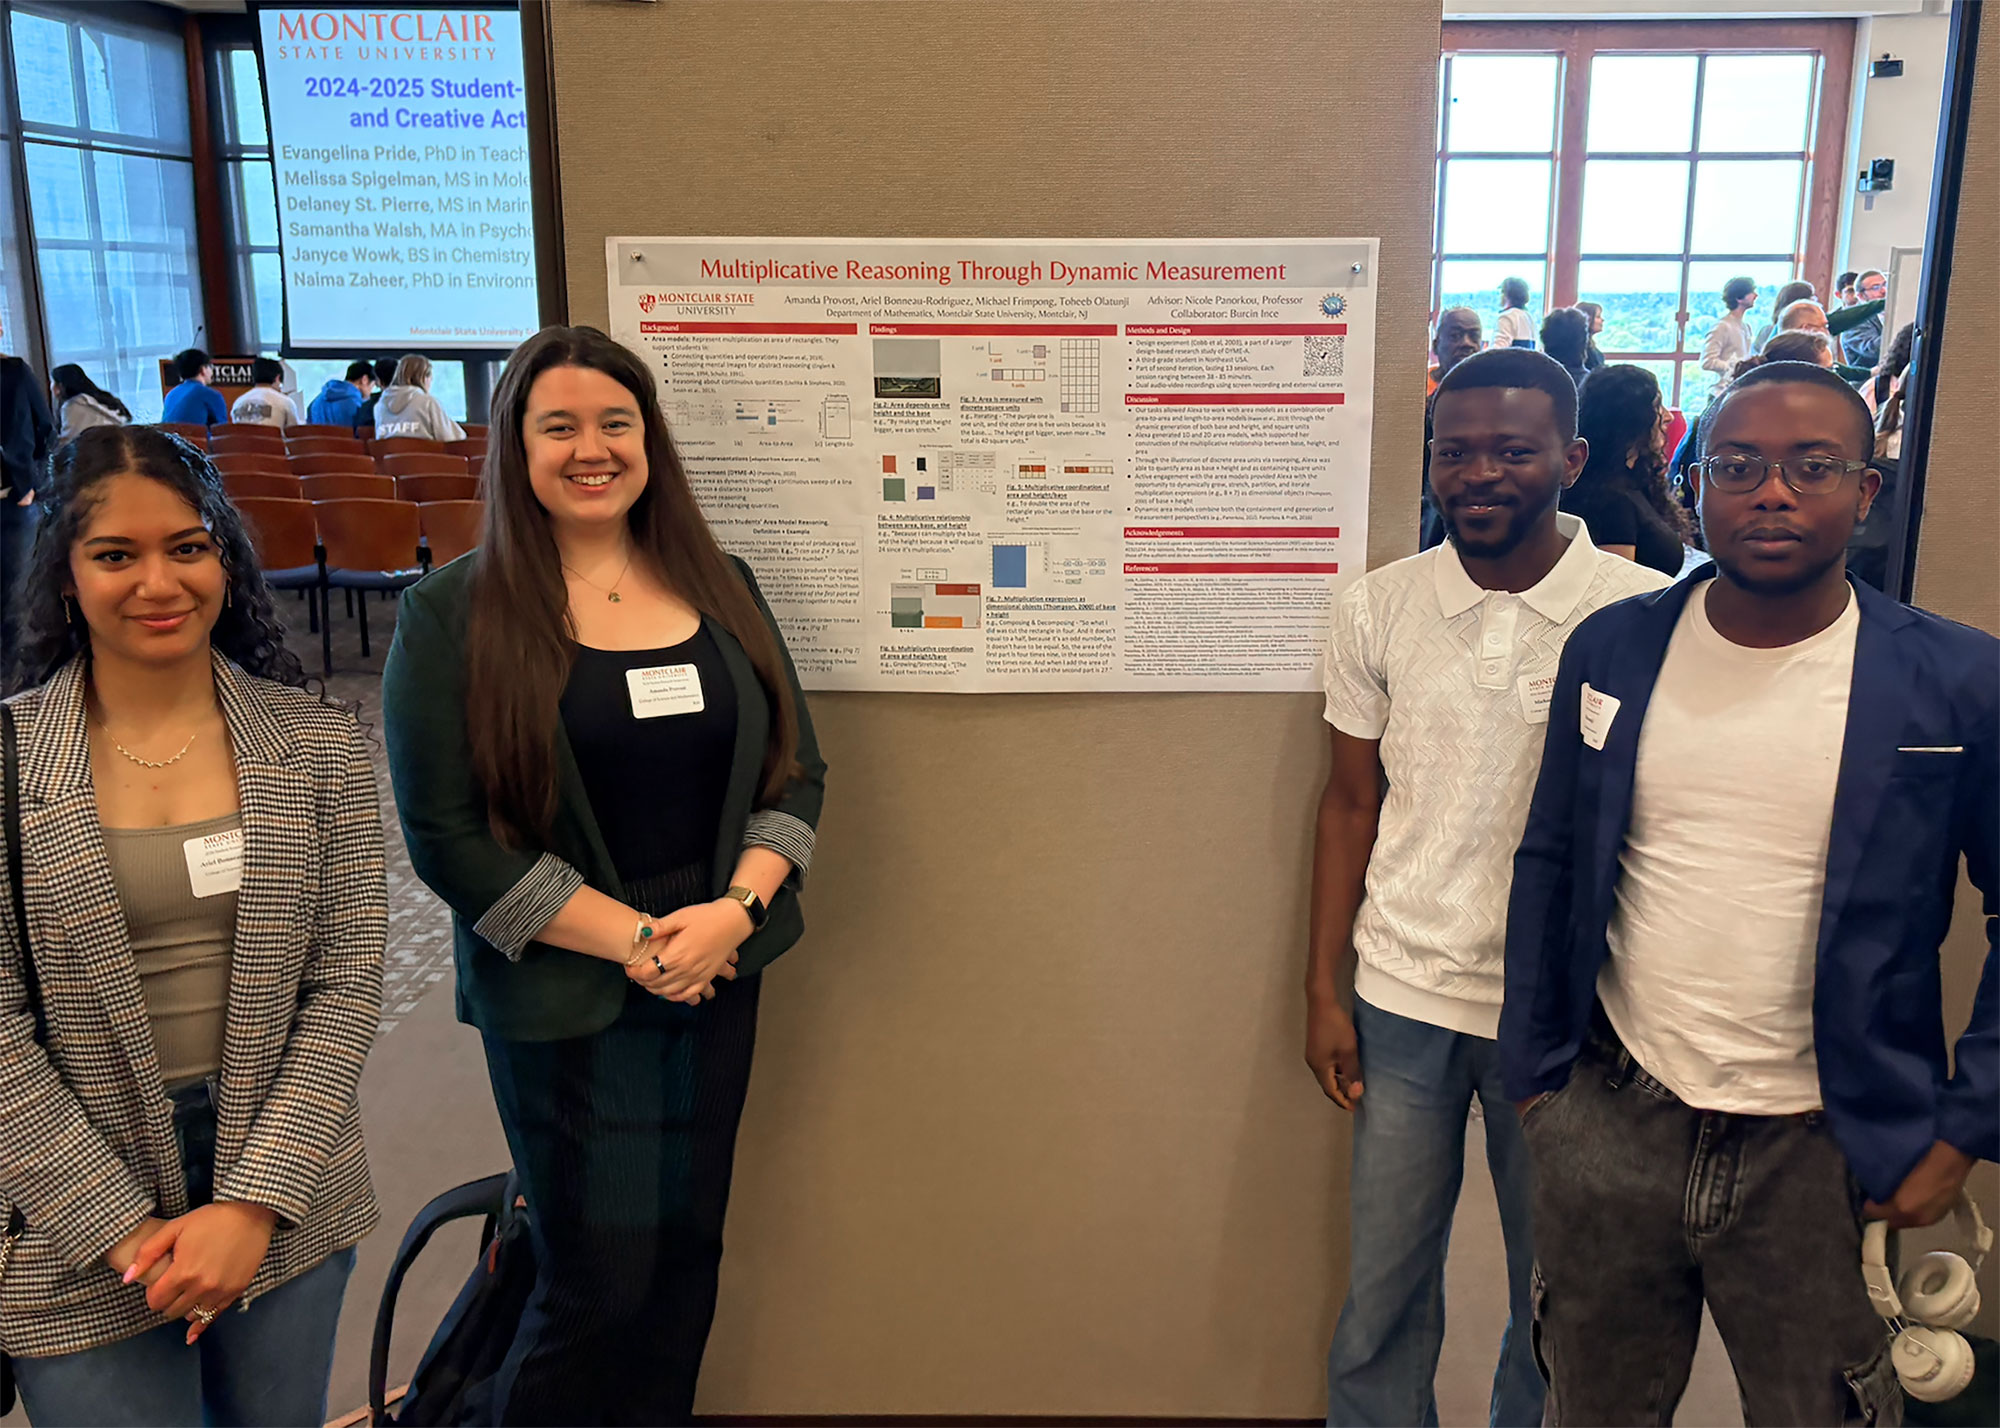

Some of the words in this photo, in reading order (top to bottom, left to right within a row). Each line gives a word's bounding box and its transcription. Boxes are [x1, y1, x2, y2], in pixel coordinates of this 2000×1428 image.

[278, 13, 495, 42] MONTCLAIR
[279, 46, 344, 60] STATE
[358, 46, 496, 61] UNIVERSITY
[304, 77, 425, 98] 2024-2025
[431, 77, 523, 98] Student-
[349, 108, 389, 128] and
[395, 108, 485, 128] Creative
[282, 146, 369, 164] Evangelina
[373, 146, 420, 164] Pride,
[424, 146, 456, 161] PhD
[461, 146, 475, 161] in
[480, 146, 527, 161] Teach
[284, 171, 347, 186] Melissa
[351, 171, 440, 190] Spigelman,
[444, 171, 470, 186] MS
[474, 171, 488, 186] in
[286, 197, 350, 215] Delaney
[354, 197, 376, 212] St.
[381, 197, 433, 215] Pierre,
[437, 197, 463, 212] MS
[467, 197, 481, 212] in
[289, 223, 370, 237] Samantha
[373, 223, 426, 241] Walsh,
[429, 223, 457, 237] MA
[460, 223, 475, 237] in
[291, 248, 348, 266] Janyce
[352, 248, 404, 266] Wowk,
[407, 248, 429, 262] BS
[432, 248, 447, 263] in
[450, 248, 530, 267] Chemistry
[700, 259, 839, 284] Multiplicative
[846, 260, 950, 284] Reasoning
[956, 260, 1043, 285] Through
[1050, 261, 1138, 285] Dynamic
[1145, 261, 1286, 280] Measurement
[294, 273, 345, 287] Naima
[348, 273, 408, 291] Zaheer,
[411, 273, 444, 288] PhD
[447, 273, 462, 288] in
[658, 294, 723, 303] MONTCLAIR
[725, 294, 754, 303] STATE
[784, 296, 821, 305] Amanda
[822, 296, 858, 307] Provost,
[859, 296, 881, 305] Ariel
[883, 296, 973, 307] Bonneau-Rodriguez,
[974, 296, 1010, 305] Michael
[1012, 296, 1057, 308] Frimpong,
[1059, 297, 1092, 306] Toheeb
[1093, 297, 1129, 308] Olatunji
[1147, 295, 1183, 305] Advisor:
[1184, 295, 1213, 305] Nicole
[1214, 295, 1259, 307] Panorkou,
[1261, 295, 1303, 305] Professor
[676, 306, 736, 315] UNIVERSITY
[826, 309, 872, 319] Department
[872, 309, 882, 317] of
[883, 309, 935, 319] Mathematics,
[936, 309, 973, 318] Montclair
[974, 310, 995, 318] State
[996, 310, 1036, 320] University,
[1037, 310, 1076, 320] Montclair,
[1077, 310, 1088, 319] NJ
[1171, 309, 1227, 318] Collaborator:
[1229, 309, 1258, 318] Burcin
[1260, 309, 1279, 318] Ince
[410, 326, 452, 335] Montclair
[454, 326, 478, 335] State
[479, 326, 524, 337] University
[641, 323, 679, 333] Background
[871, 326, 897, 335] Findings
[1169, 327, 1191, 335] Design
[722, 336, 762, 344] multiplication
[671, 353, 704, 361] Connecting
[704, 353, 733, 361] quantities
[746, 353, 778, 361] operations
[213, 365, 252, 376] TCLAI
[782, 362, 811, 370] reasoning
[1126, 395, 1159, 403] Discussion
[379, 422, 419, 436] STAFF
[1125, 529, 1184, 537] Acknowledgements
[1125, 564, 1159, 572] References
[641, 667, 686, 676] MONTCLAIR
